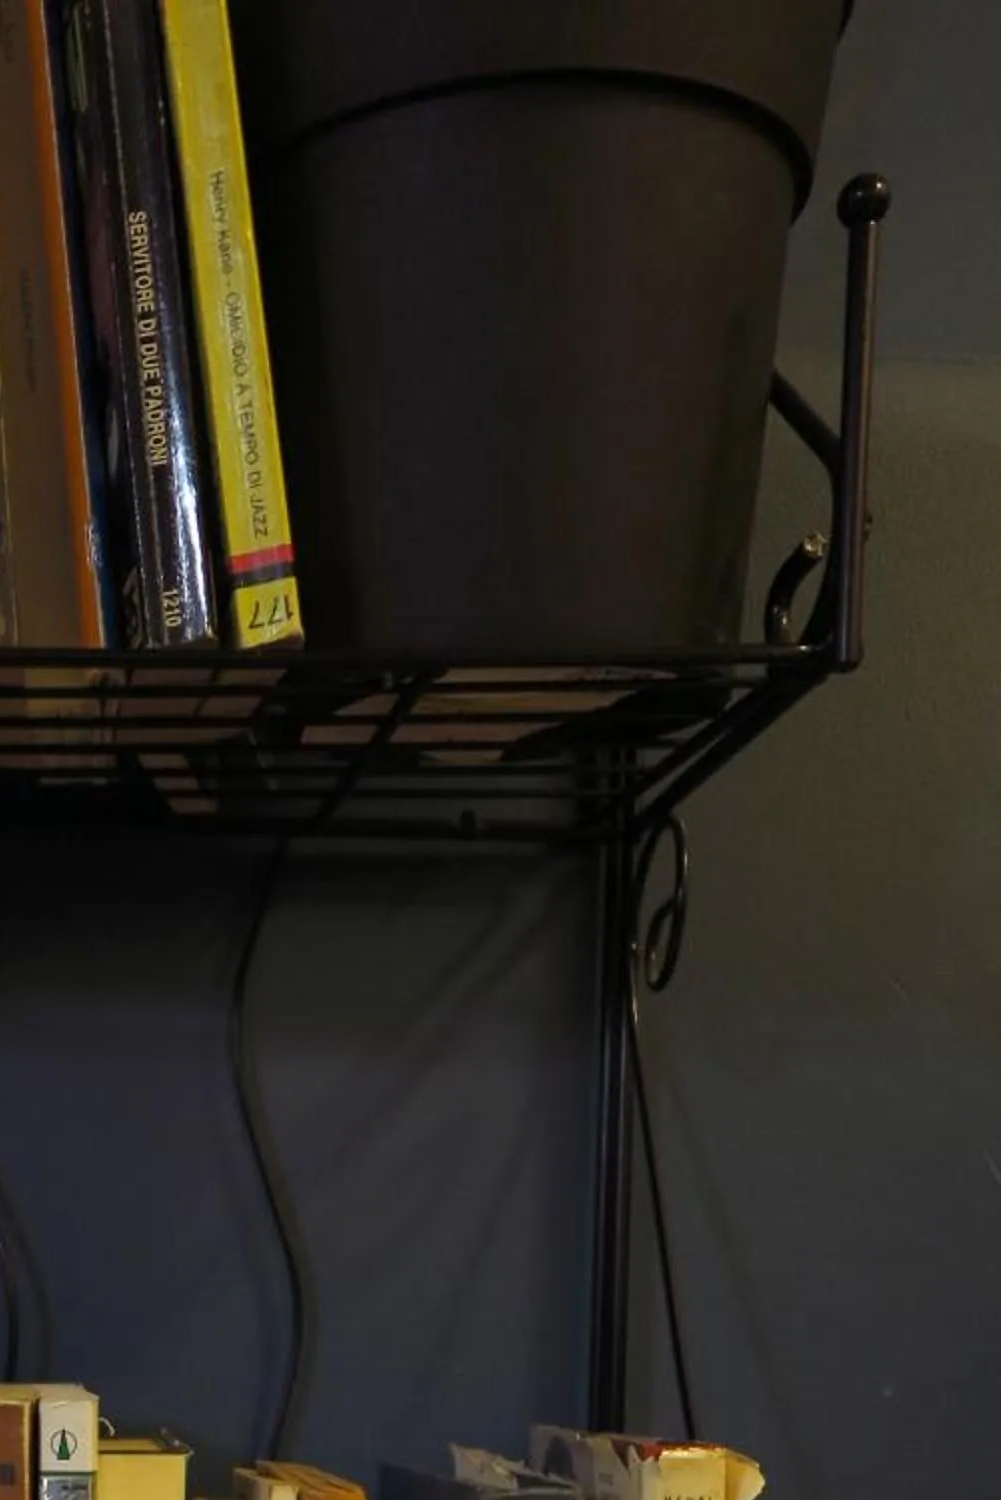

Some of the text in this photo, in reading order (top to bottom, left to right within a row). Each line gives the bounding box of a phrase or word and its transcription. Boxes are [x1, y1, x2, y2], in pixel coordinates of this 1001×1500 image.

[128, 211, 169, 466] SERVITORE DI DUE PADRONI
[208, 170, 269, 541] Henry Kane OMICIDIO A TEMPO DI JAZZ
[161, 588, 182, 628] 1210
[247, 594, 295, 631] 177
